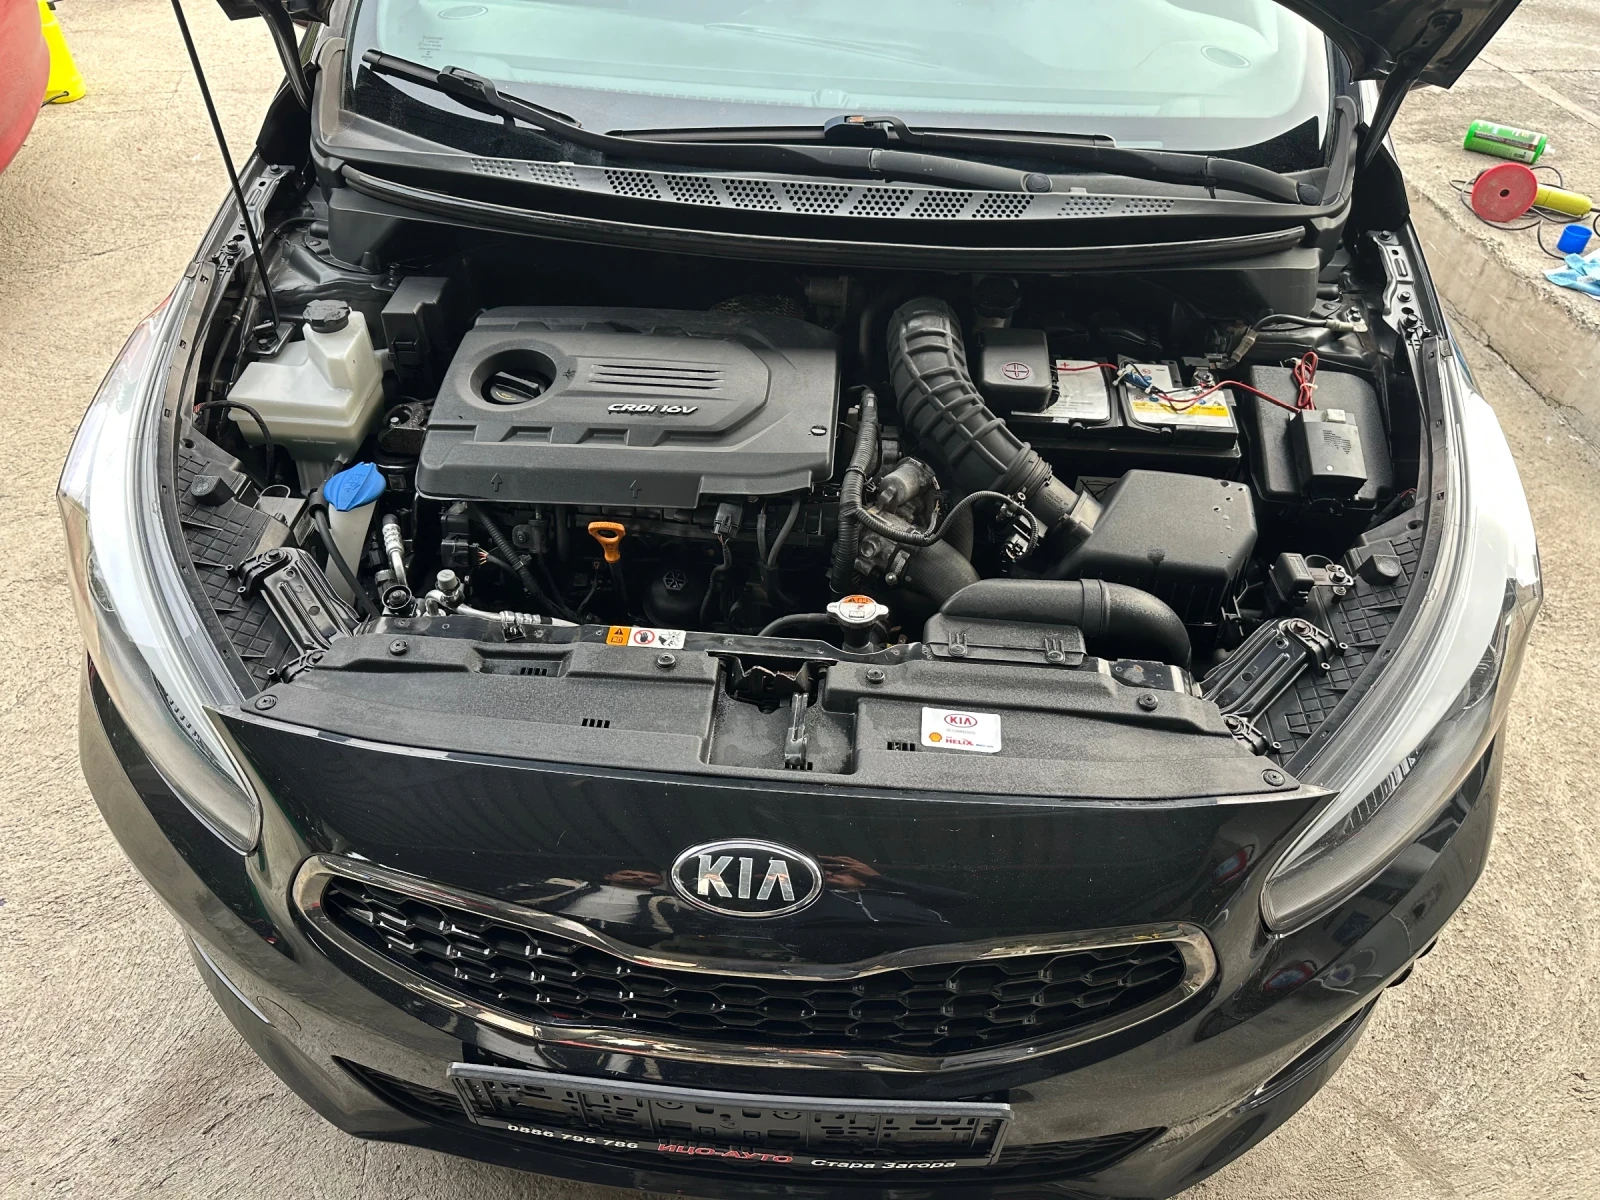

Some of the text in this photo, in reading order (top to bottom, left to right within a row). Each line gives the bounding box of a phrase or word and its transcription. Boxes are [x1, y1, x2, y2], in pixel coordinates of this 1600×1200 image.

[607, 403, 698, 415] CRDi 16V
[949, 716, 972, 726] KIA
[945, 738, 974, 747] HELIX
[698, 854, 795, 901] KIA
[507, 1124, 639, 1149] 0886 795 786
[658, 1143, 793, 1163] ИЦО-АУТО
[811, 1159, 876, 1169] Стара
